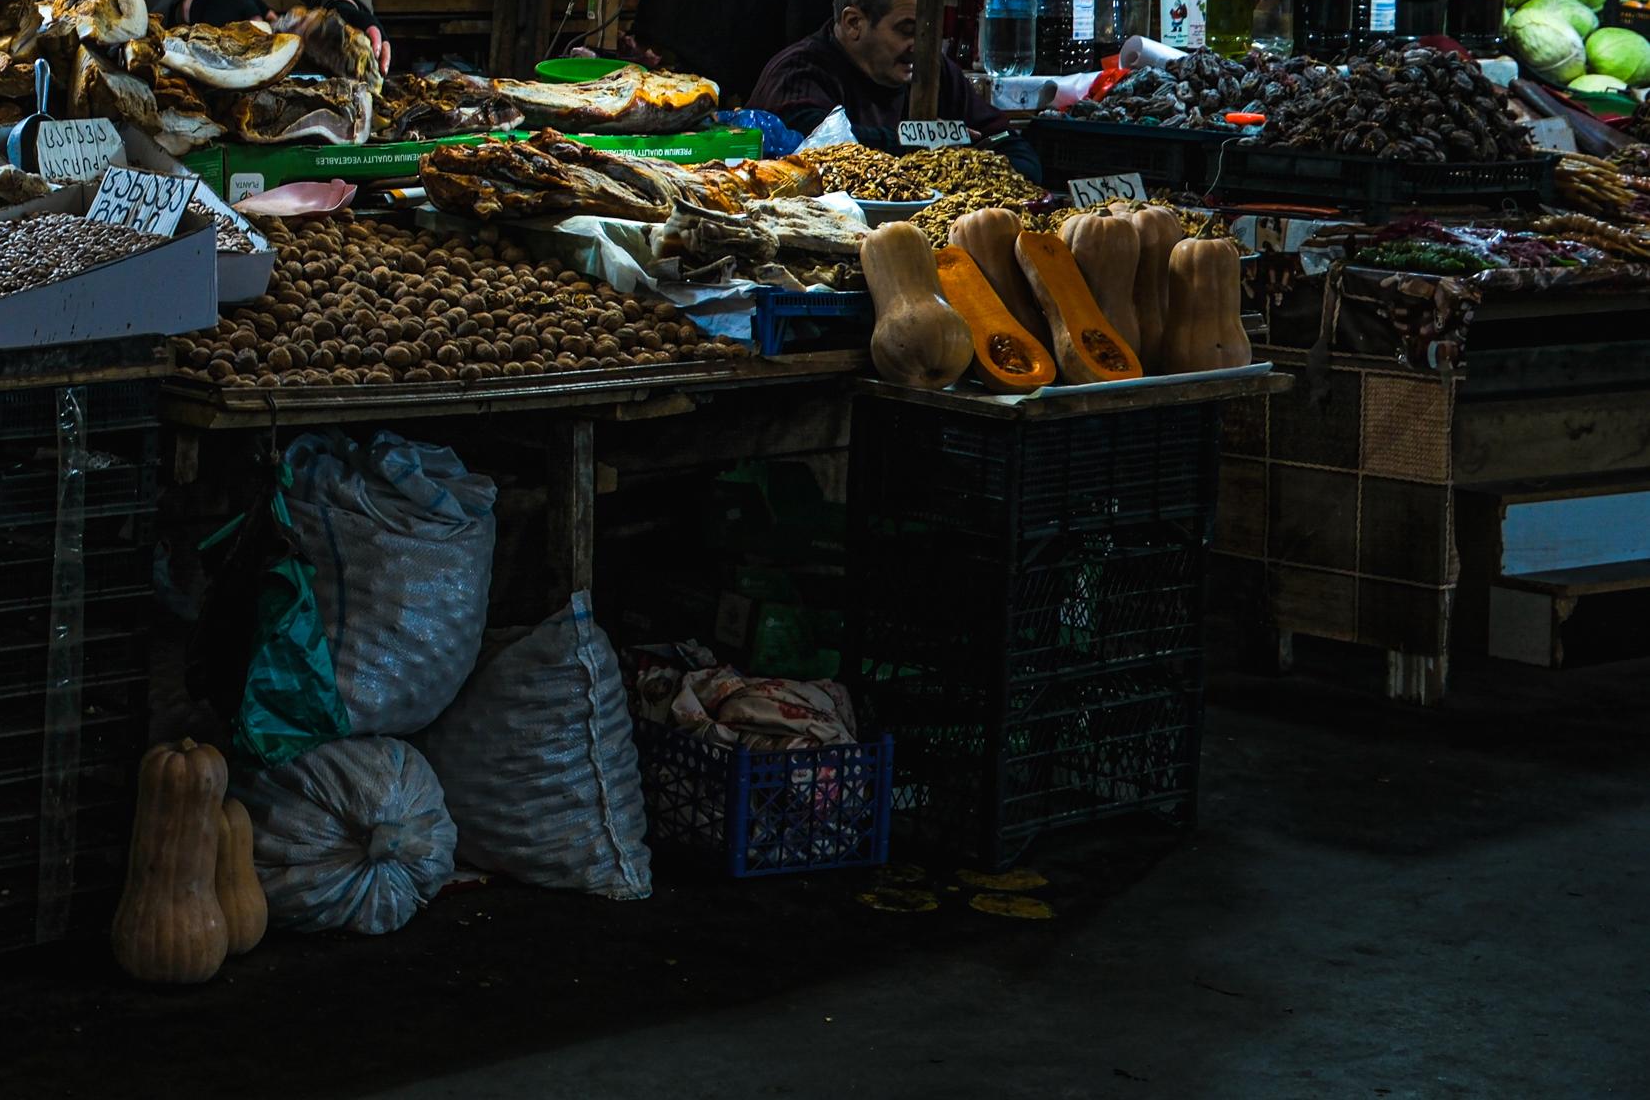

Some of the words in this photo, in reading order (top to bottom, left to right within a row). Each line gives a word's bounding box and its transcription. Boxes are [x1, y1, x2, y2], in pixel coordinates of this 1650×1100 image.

[44, 123, 107, 148] ცანავა
[664, 148, 692, 156] PREMIUM
[315, 156, 362, 165] VEGETABLES
[363, 155, 393, 164] QUALITY
[101, 167, 186, 212] ცანავა
[236, 181, 259, 189] PLANTA
